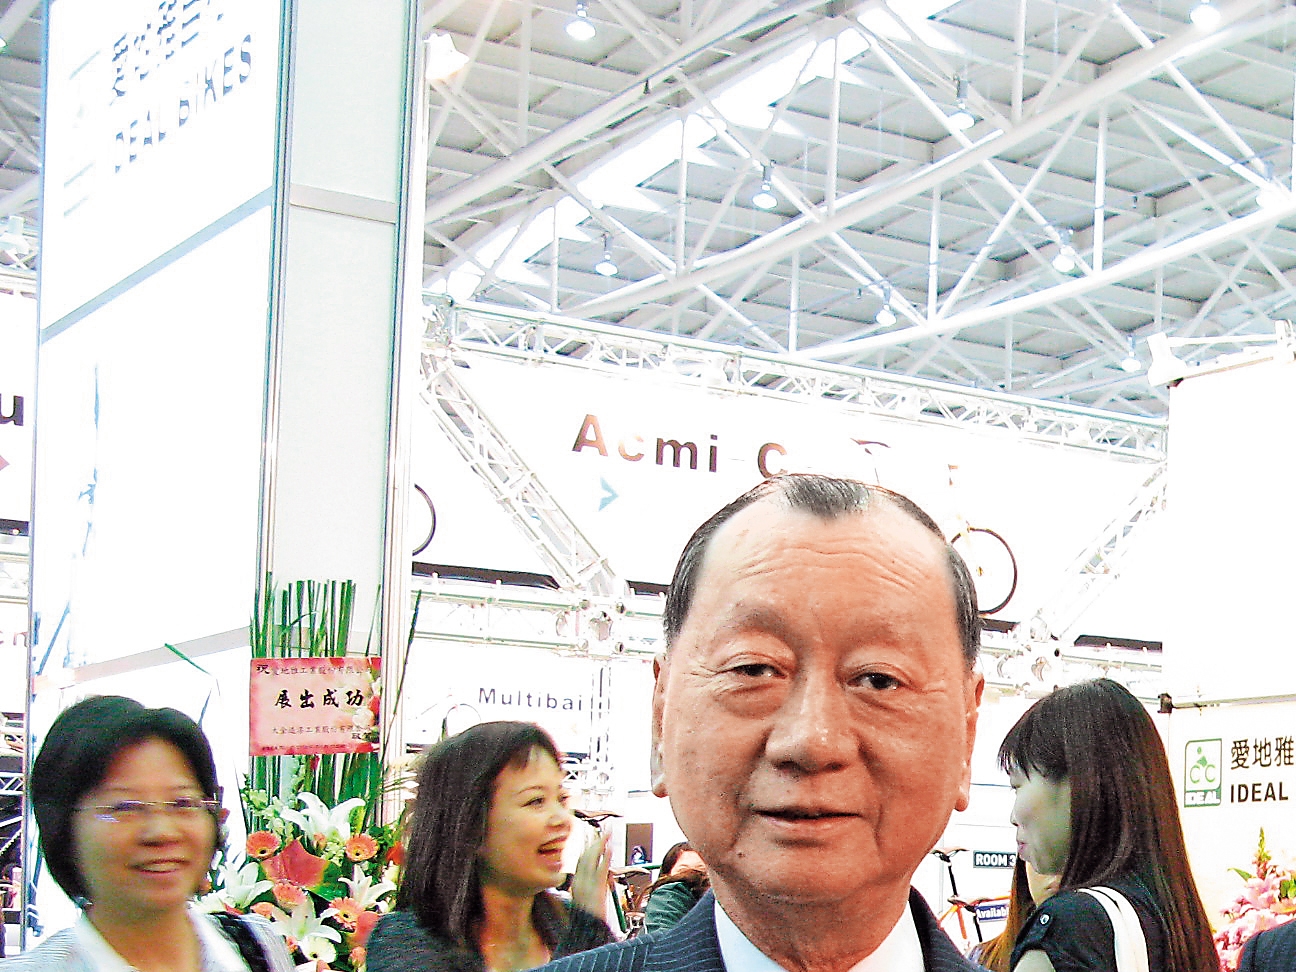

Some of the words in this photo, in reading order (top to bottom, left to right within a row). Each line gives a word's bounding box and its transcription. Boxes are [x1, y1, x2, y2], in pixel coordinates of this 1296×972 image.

[275, 688, 364, 709] 展出成功
[1230, 781, 1289, 804] IDEAL
[975, 853, 1008, 867] ROOM
